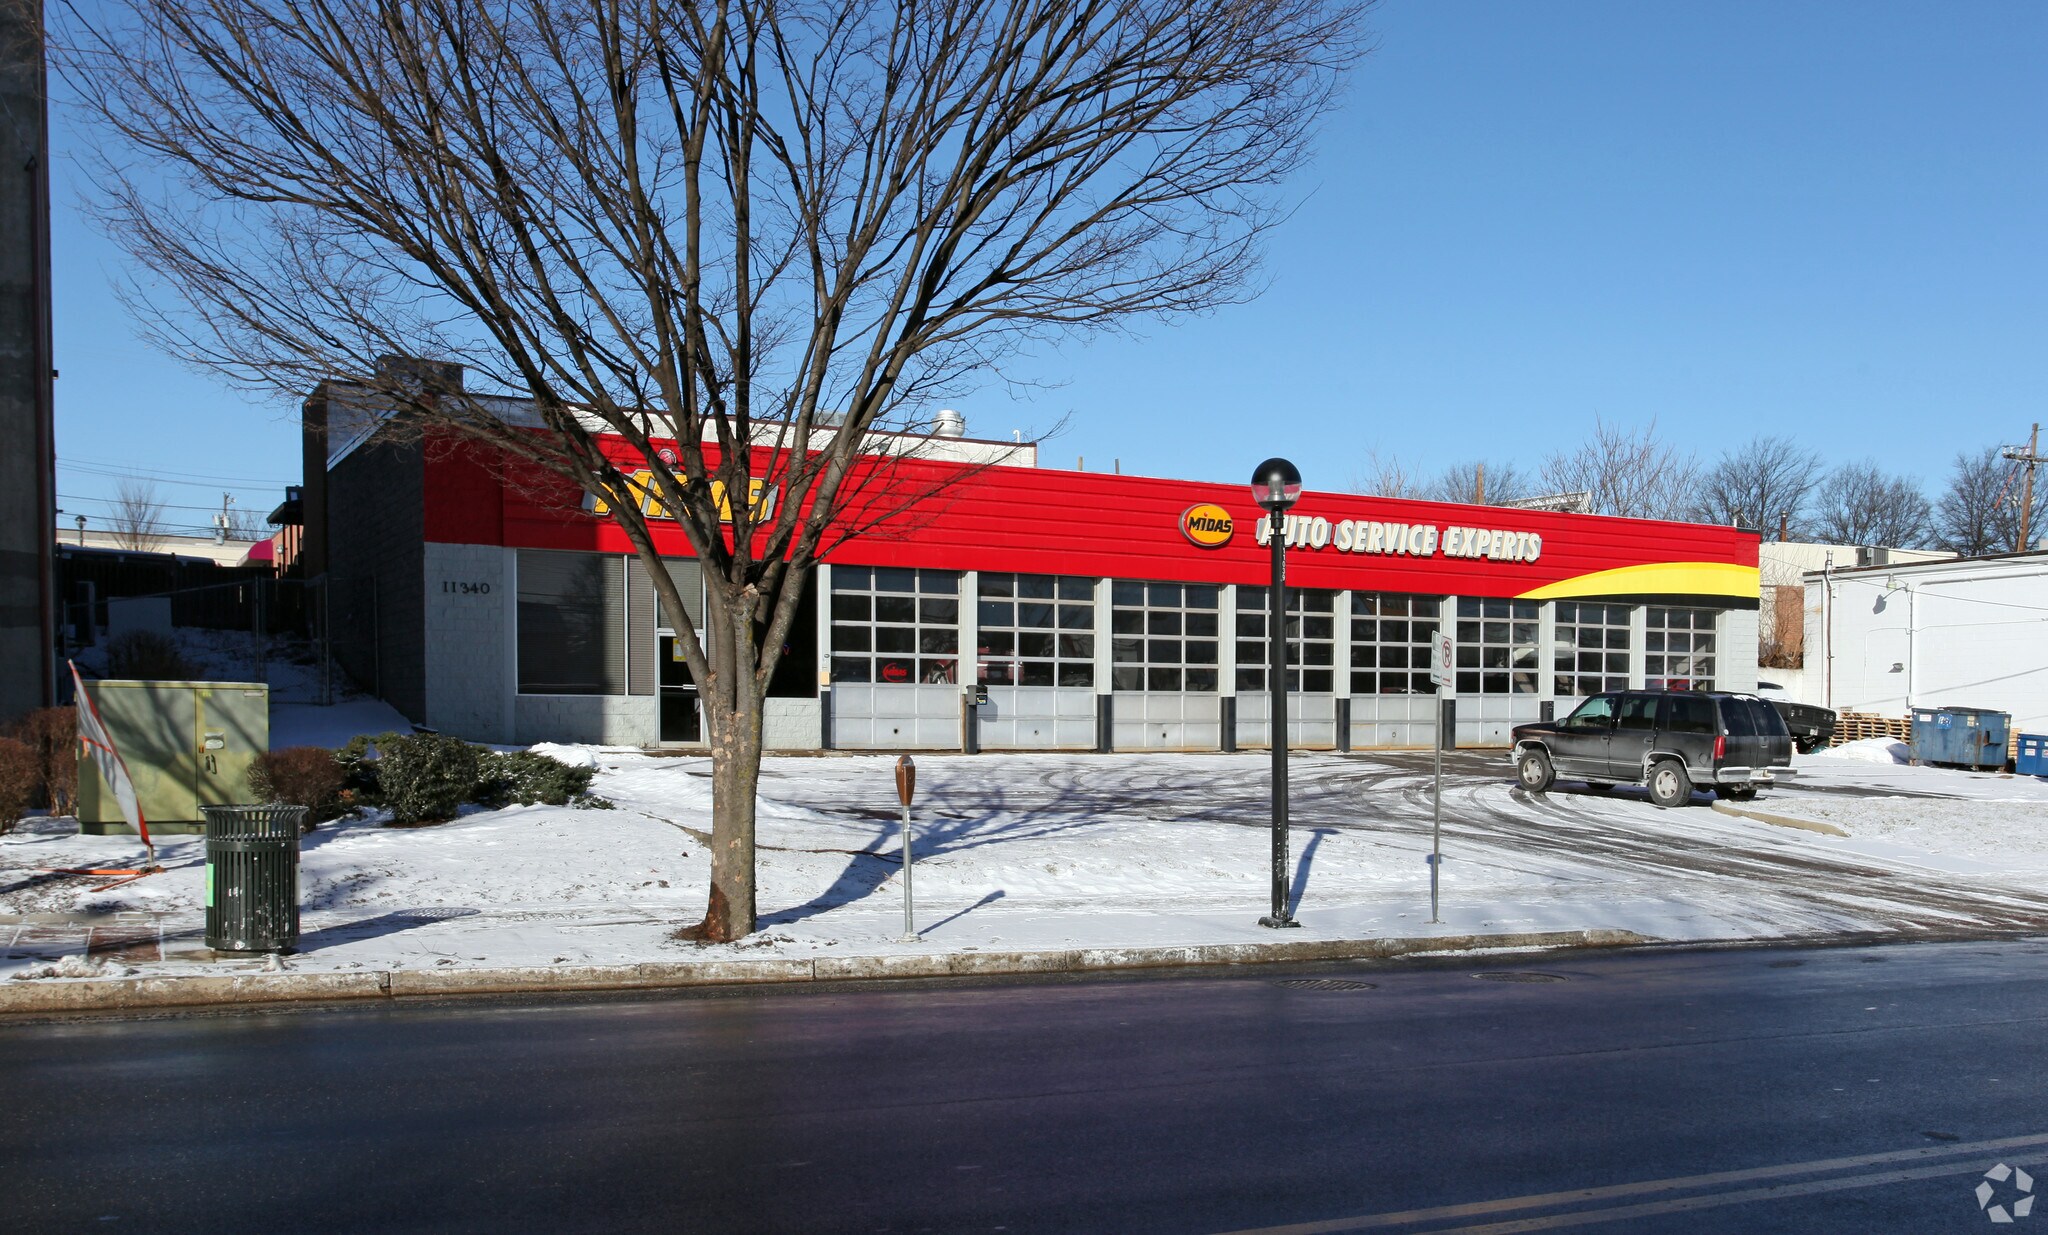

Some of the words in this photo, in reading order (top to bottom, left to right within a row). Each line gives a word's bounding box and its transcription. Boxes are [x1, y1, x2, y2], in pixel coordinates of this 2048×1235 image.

[1188, 512, 1232, 533] MIDAS
[1257, 513, 1328, 550] AUTO
[1336, 518, 1437, 556] SERVICE
[1443, 525, 1542, 563] EXPERTS
[442, 581, 491, 595] 11340
